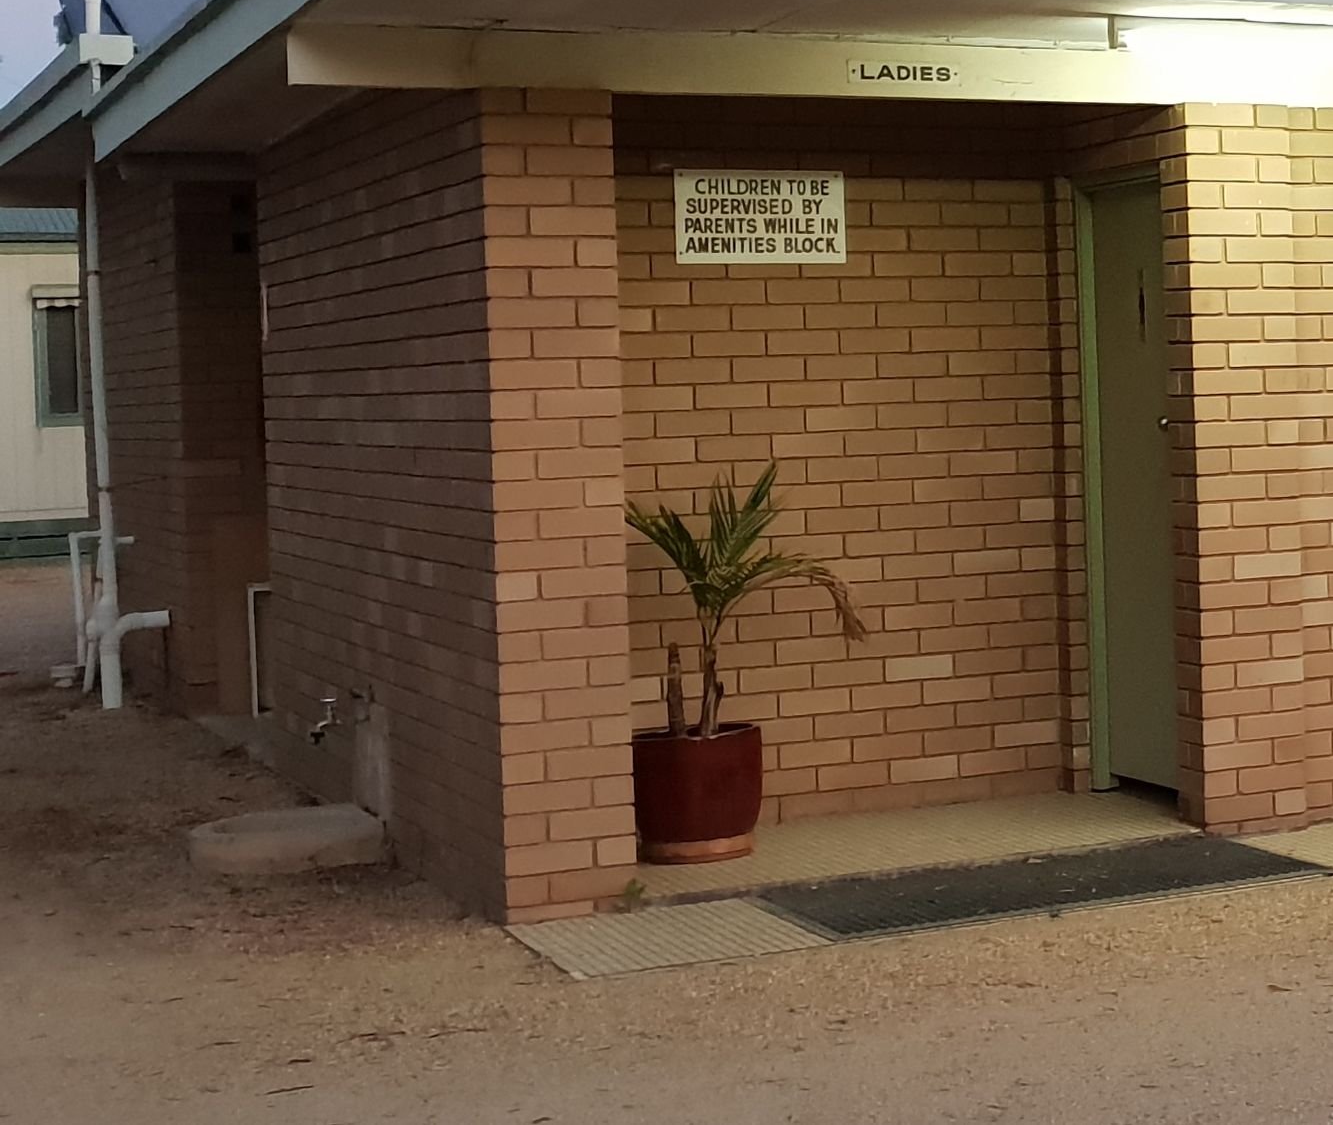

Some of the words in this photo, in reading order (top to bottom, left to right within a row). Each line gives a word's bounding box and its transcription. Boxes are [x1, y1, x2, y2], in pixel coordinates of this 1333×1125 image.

[860, 64, 951, 81] LADIES
[695, 179, 781, 196] CHILDREN
[787, 179, 806, 196] TO
[811, 180, 829, 196] BE
[686, 198, 793, 215] SUPERVISED
[802, 199, 824, 215] BY
[684, 218, 757, 235] PARENTS
[764, 218, 815, 235] WHILE
[820, 218, 838, 234] IN
[685, 237, 777, 254] AMENITIES
